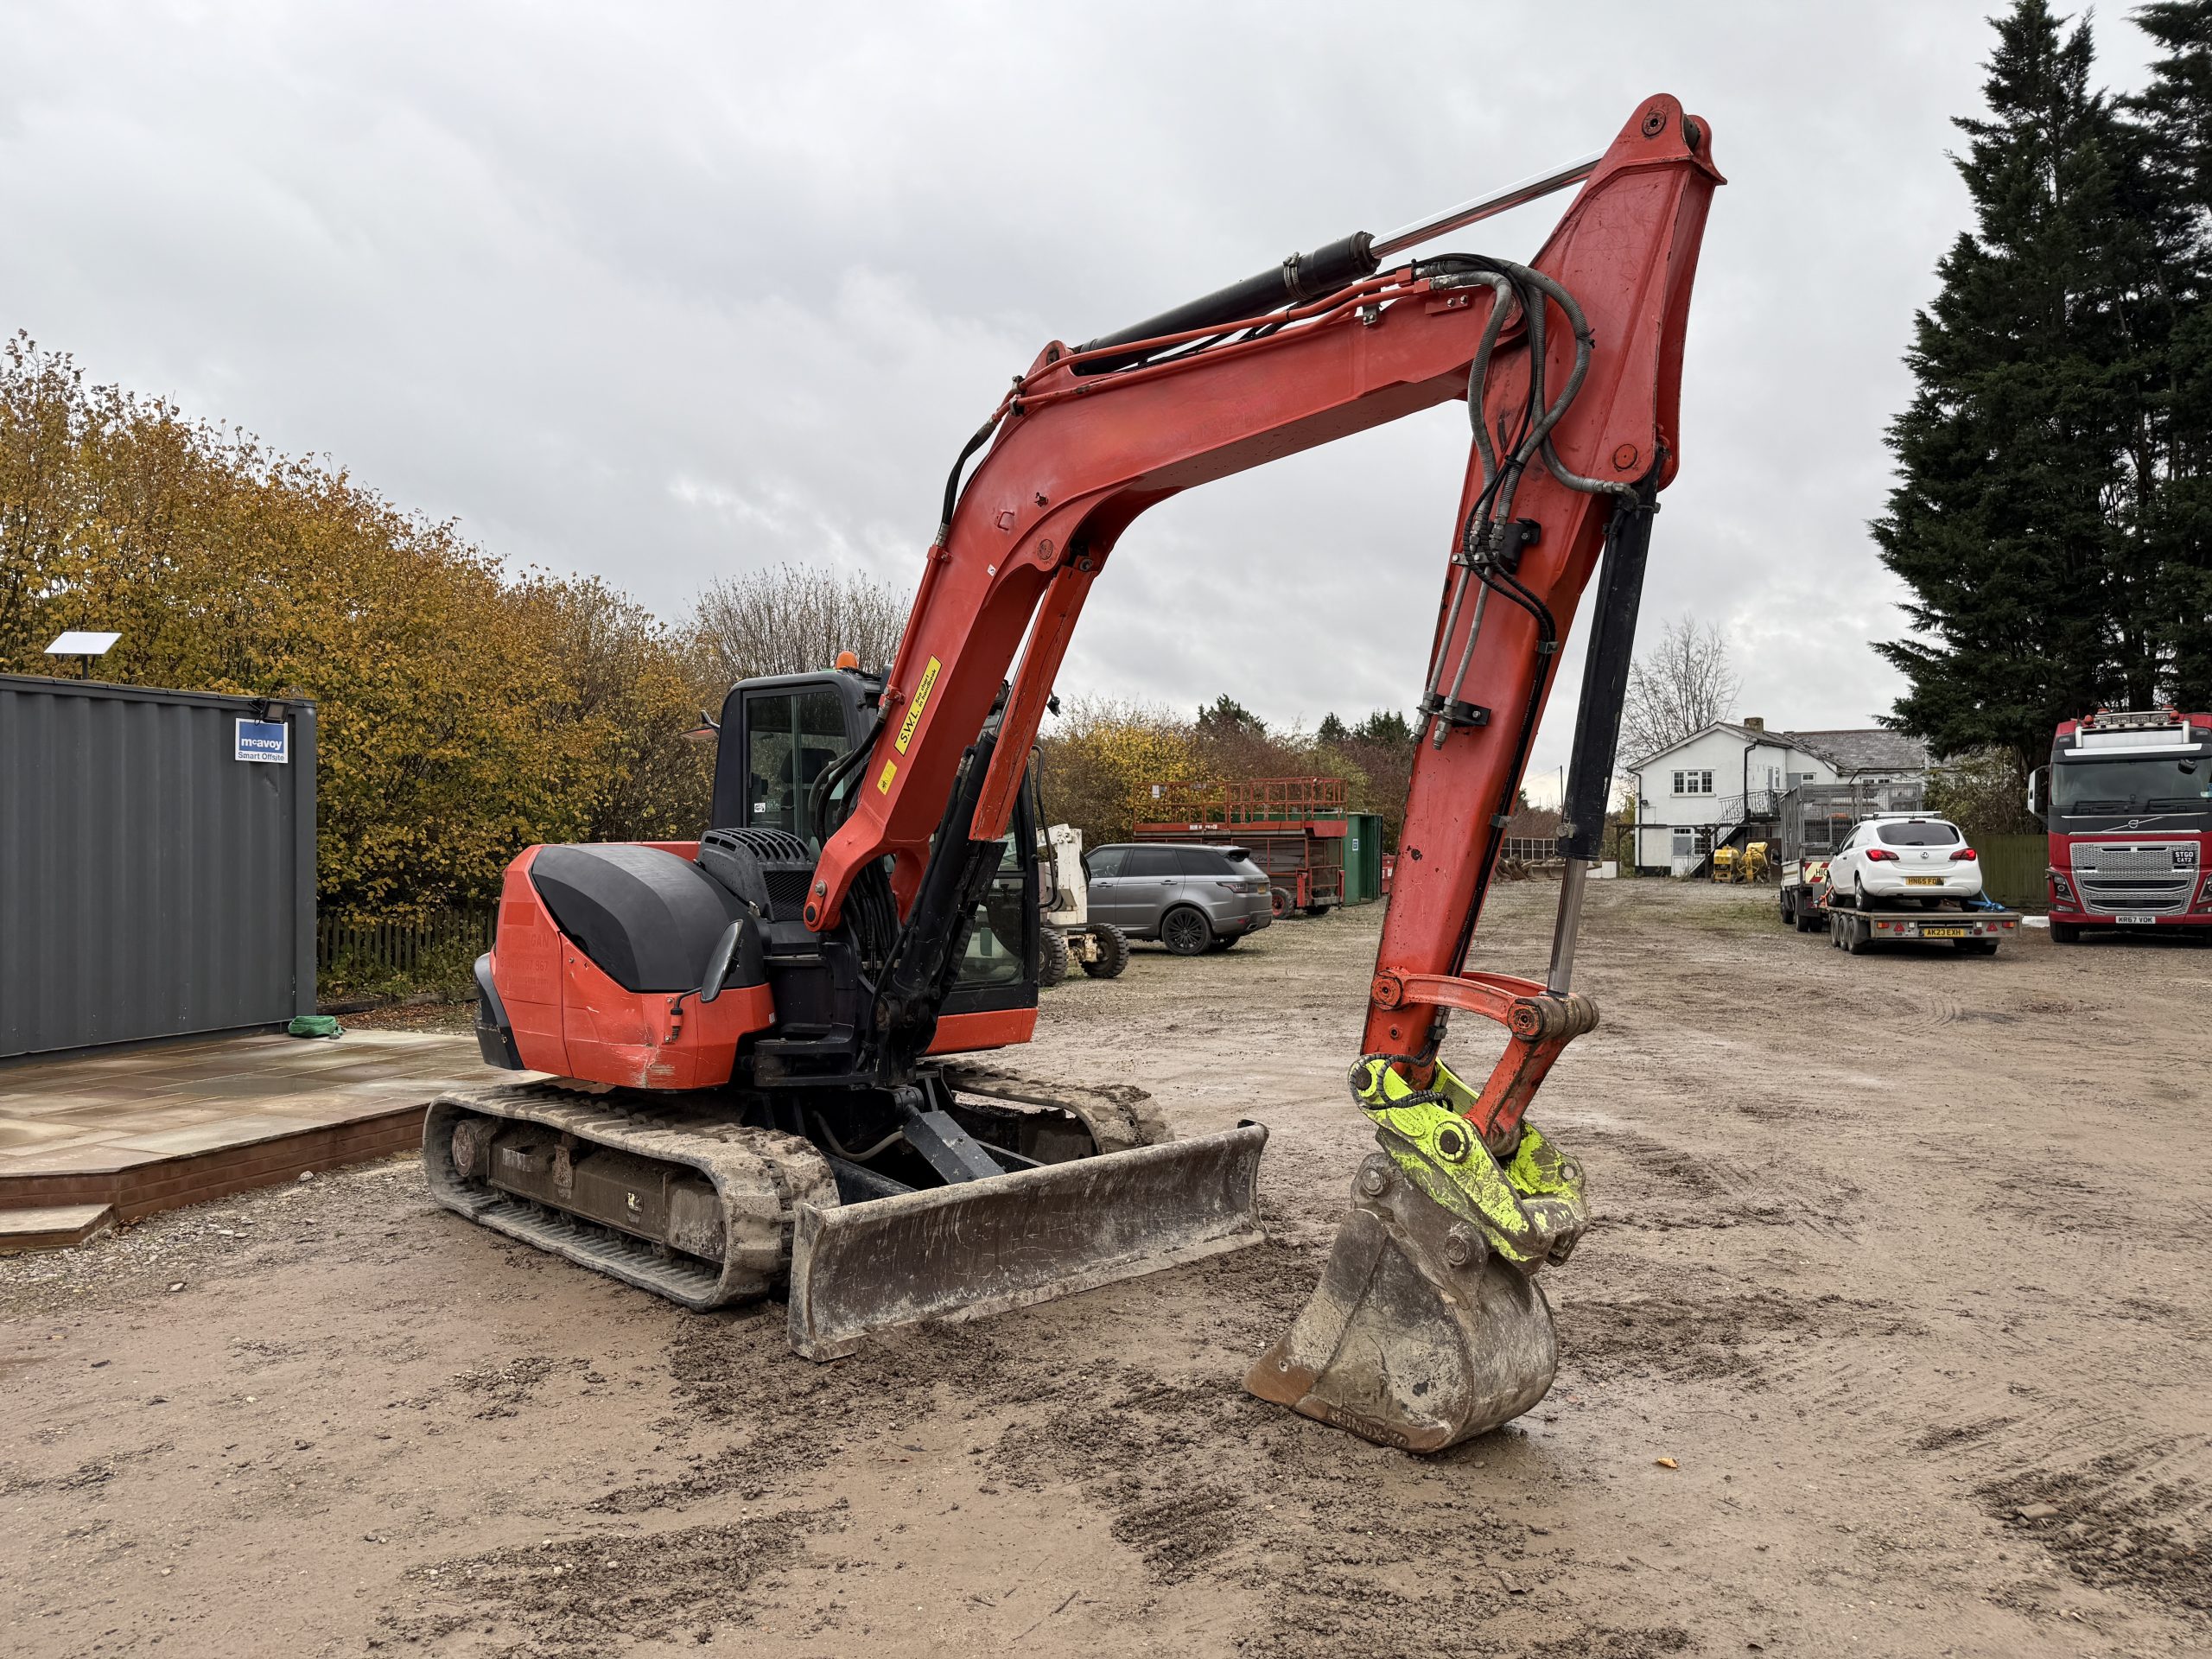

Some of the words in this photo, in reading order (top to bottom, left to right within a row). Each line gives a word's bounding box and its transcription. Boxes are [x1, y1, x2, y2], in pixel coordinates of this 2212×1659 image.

[921, 674, 930, 691] chart
[922, 669, 937, 701] handbook
[900, 710, 919, 743] S.W.L.
[262, 753, 284, 761] Offsite
[1908, 877, 1927, 886] HN65
